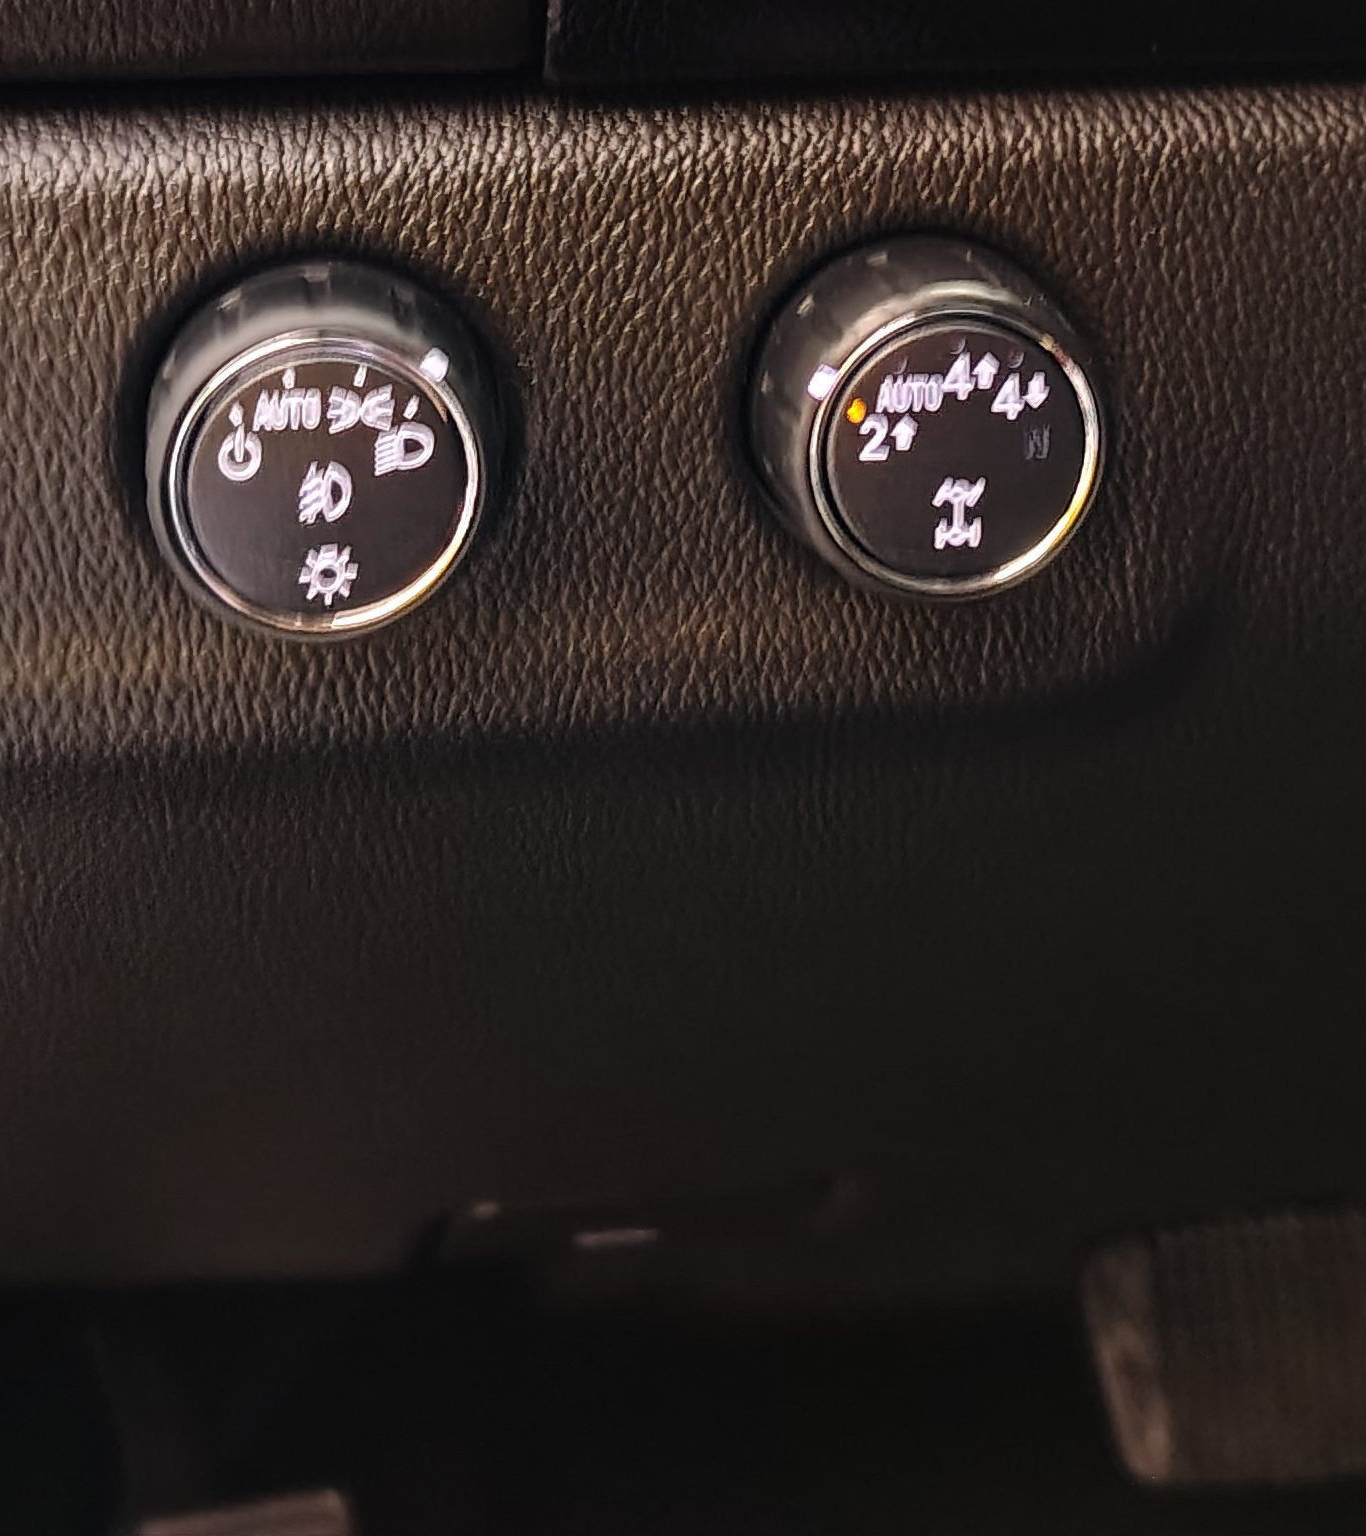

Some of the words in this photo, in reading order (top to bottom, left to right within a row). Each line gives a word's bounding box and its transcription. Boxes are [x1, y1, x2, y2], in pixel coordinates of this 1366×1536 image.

[875, 373, 944, 413] AUTO
[943, 351, 976, 400] 4
[991, 373, 1024, 420] 4
[252, 388, 323, 432] AUTO
[858, 415, 891, 461] 2
